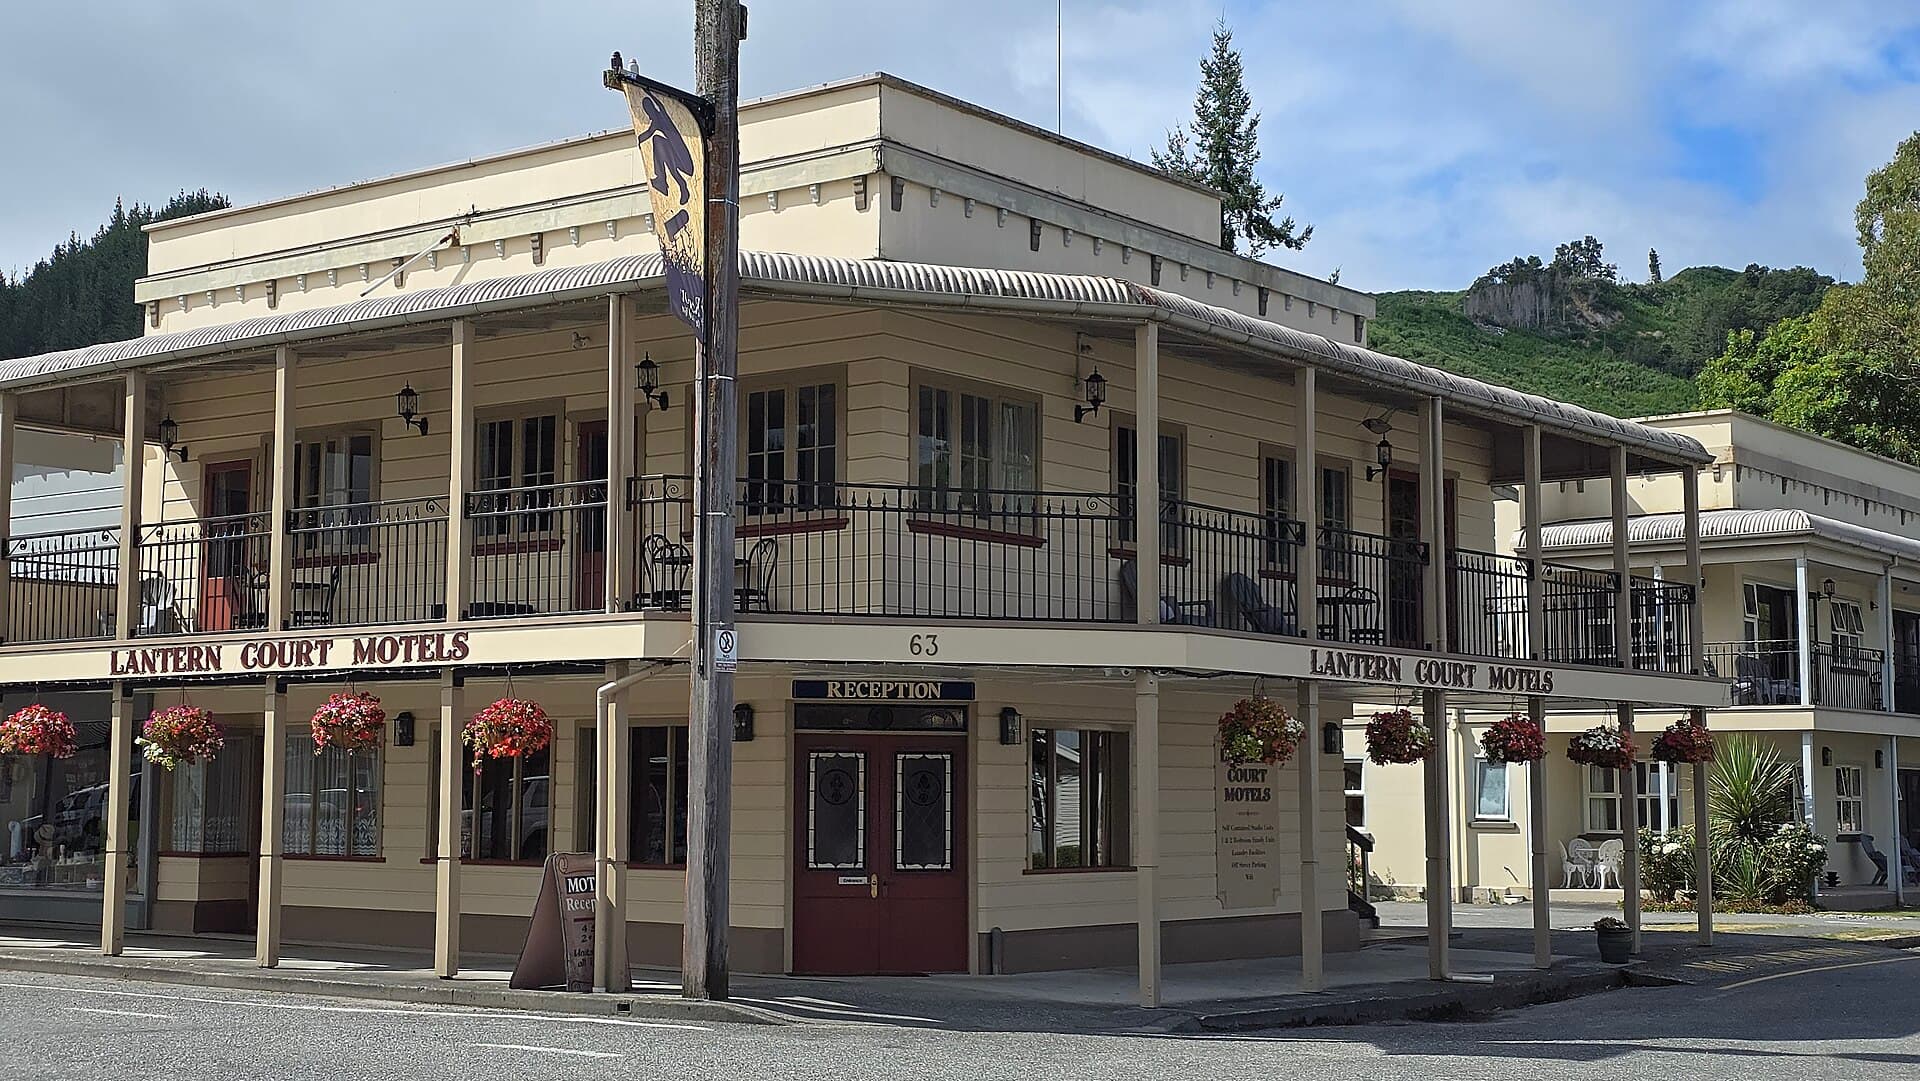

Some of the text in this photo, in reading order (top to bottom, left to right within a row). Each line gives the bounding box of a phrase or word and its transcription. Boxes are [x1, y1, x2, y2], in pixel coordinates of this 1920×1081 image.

[110, 631, 470, 675] LANTERN COURT MOTELS
[910, 634, 938, 656] 63
[1309, 649, 1553, 694] LANTERN COURT MOTELS
[827, 681, 942, 698] RECEPTION
[1227, 768, 1267, 783] COURT
[1224, 787, 1271, 802] MOTELS
